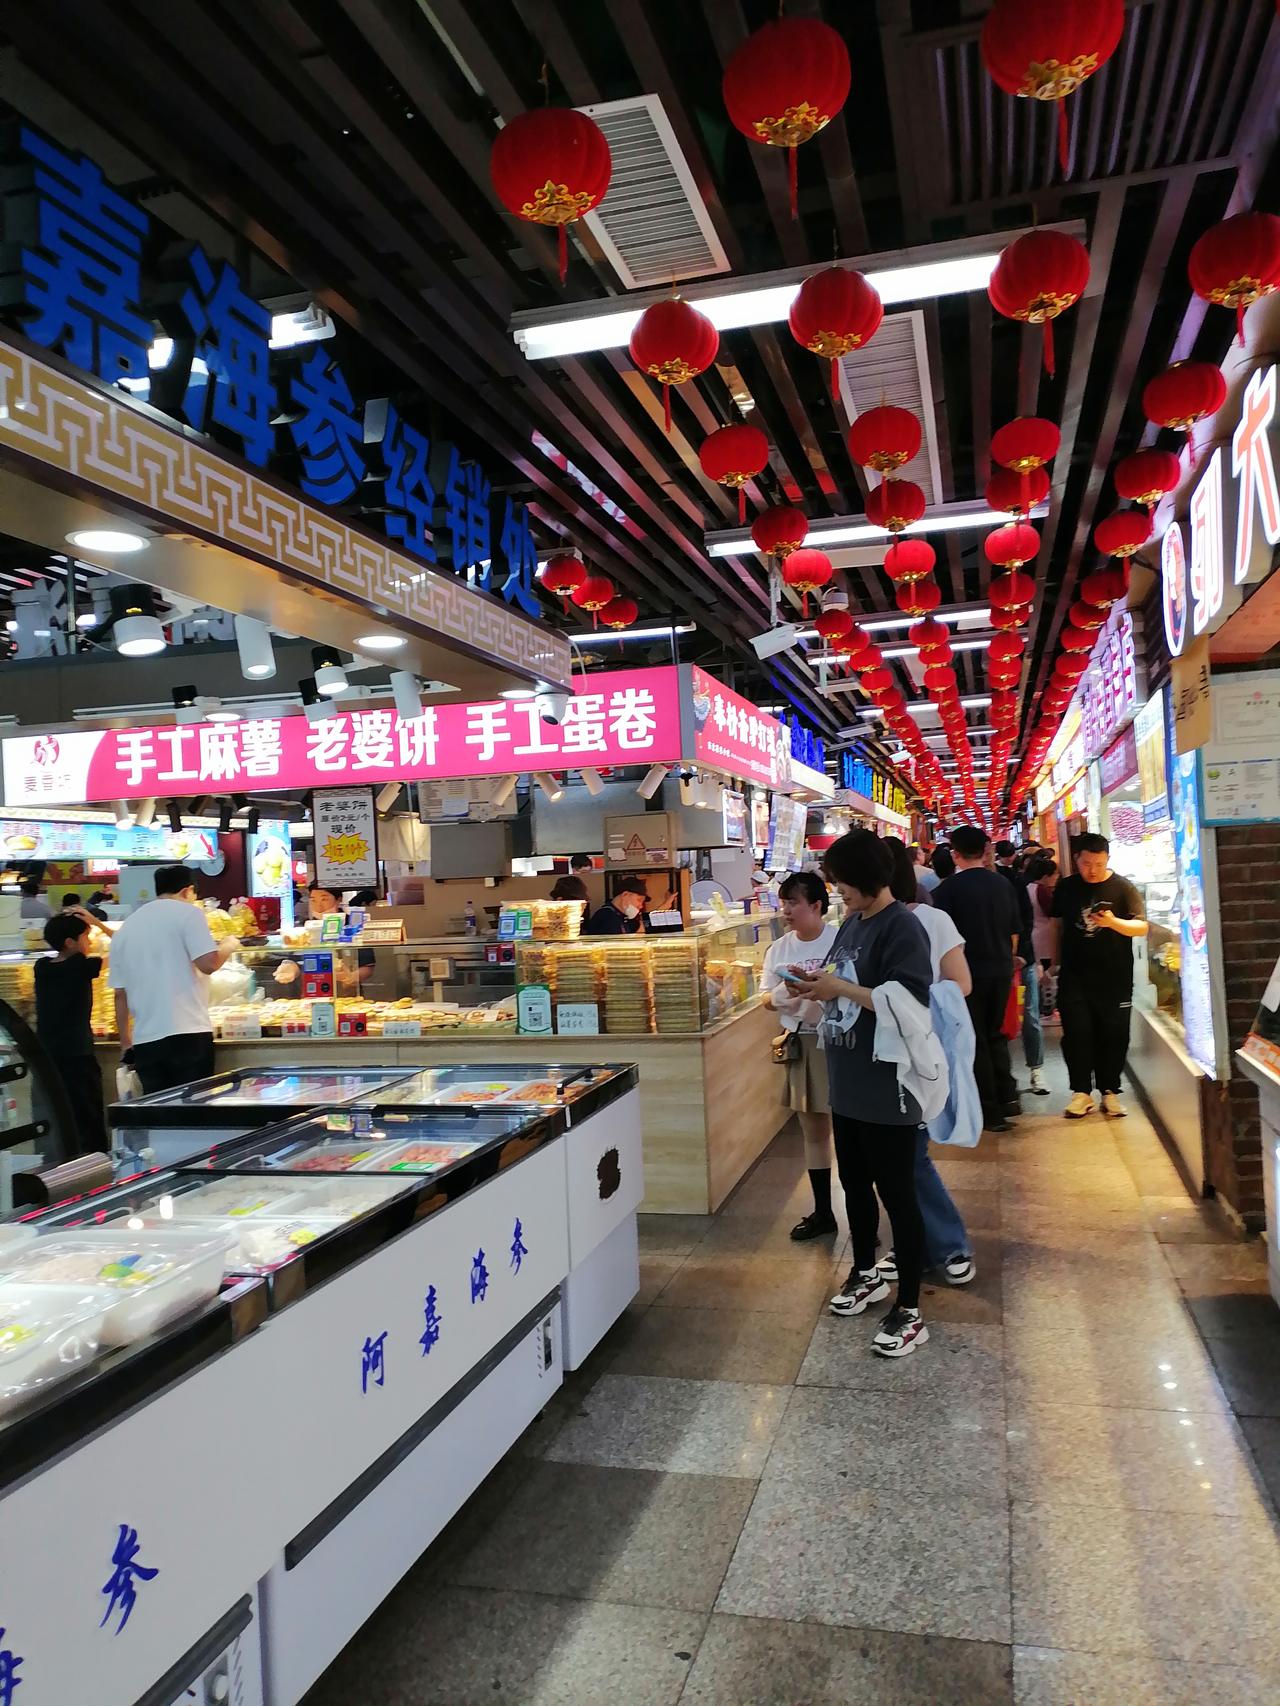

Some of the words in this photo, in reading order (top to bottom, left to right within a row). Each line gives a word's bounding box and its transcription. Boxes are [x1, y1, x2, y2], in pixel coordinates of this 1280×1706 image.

[20, 126, 541, 620] 嘉海参经销处
[115, 719, 283, 786] 手工麻薯
[306, 707, 440, 772] 老婆饼
[465, 688, 657, 761] 手工蛋卷
[320, 799, 368, 811] 老婆饼
